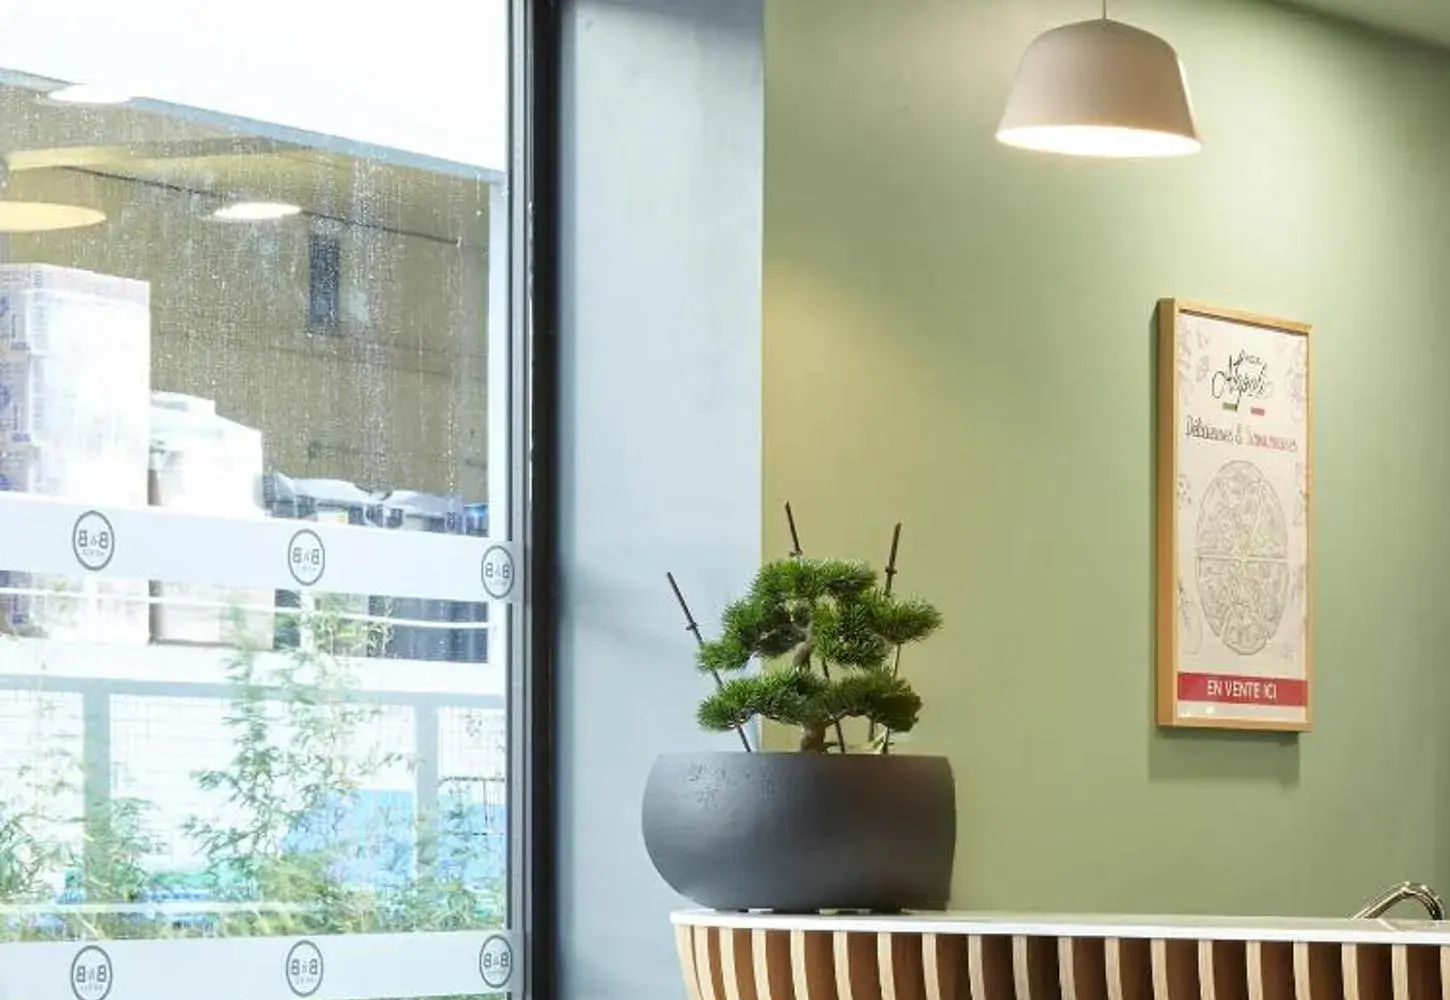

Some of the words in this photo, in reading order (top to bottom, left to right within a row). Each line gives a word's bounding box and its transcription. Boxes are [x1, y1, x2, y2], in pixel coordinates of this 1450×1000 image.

[1208, 680, 1222, 696] EN
[1225, 681, 1260, 698] VENTE
[1264, 683, 1277, 699] ICI
